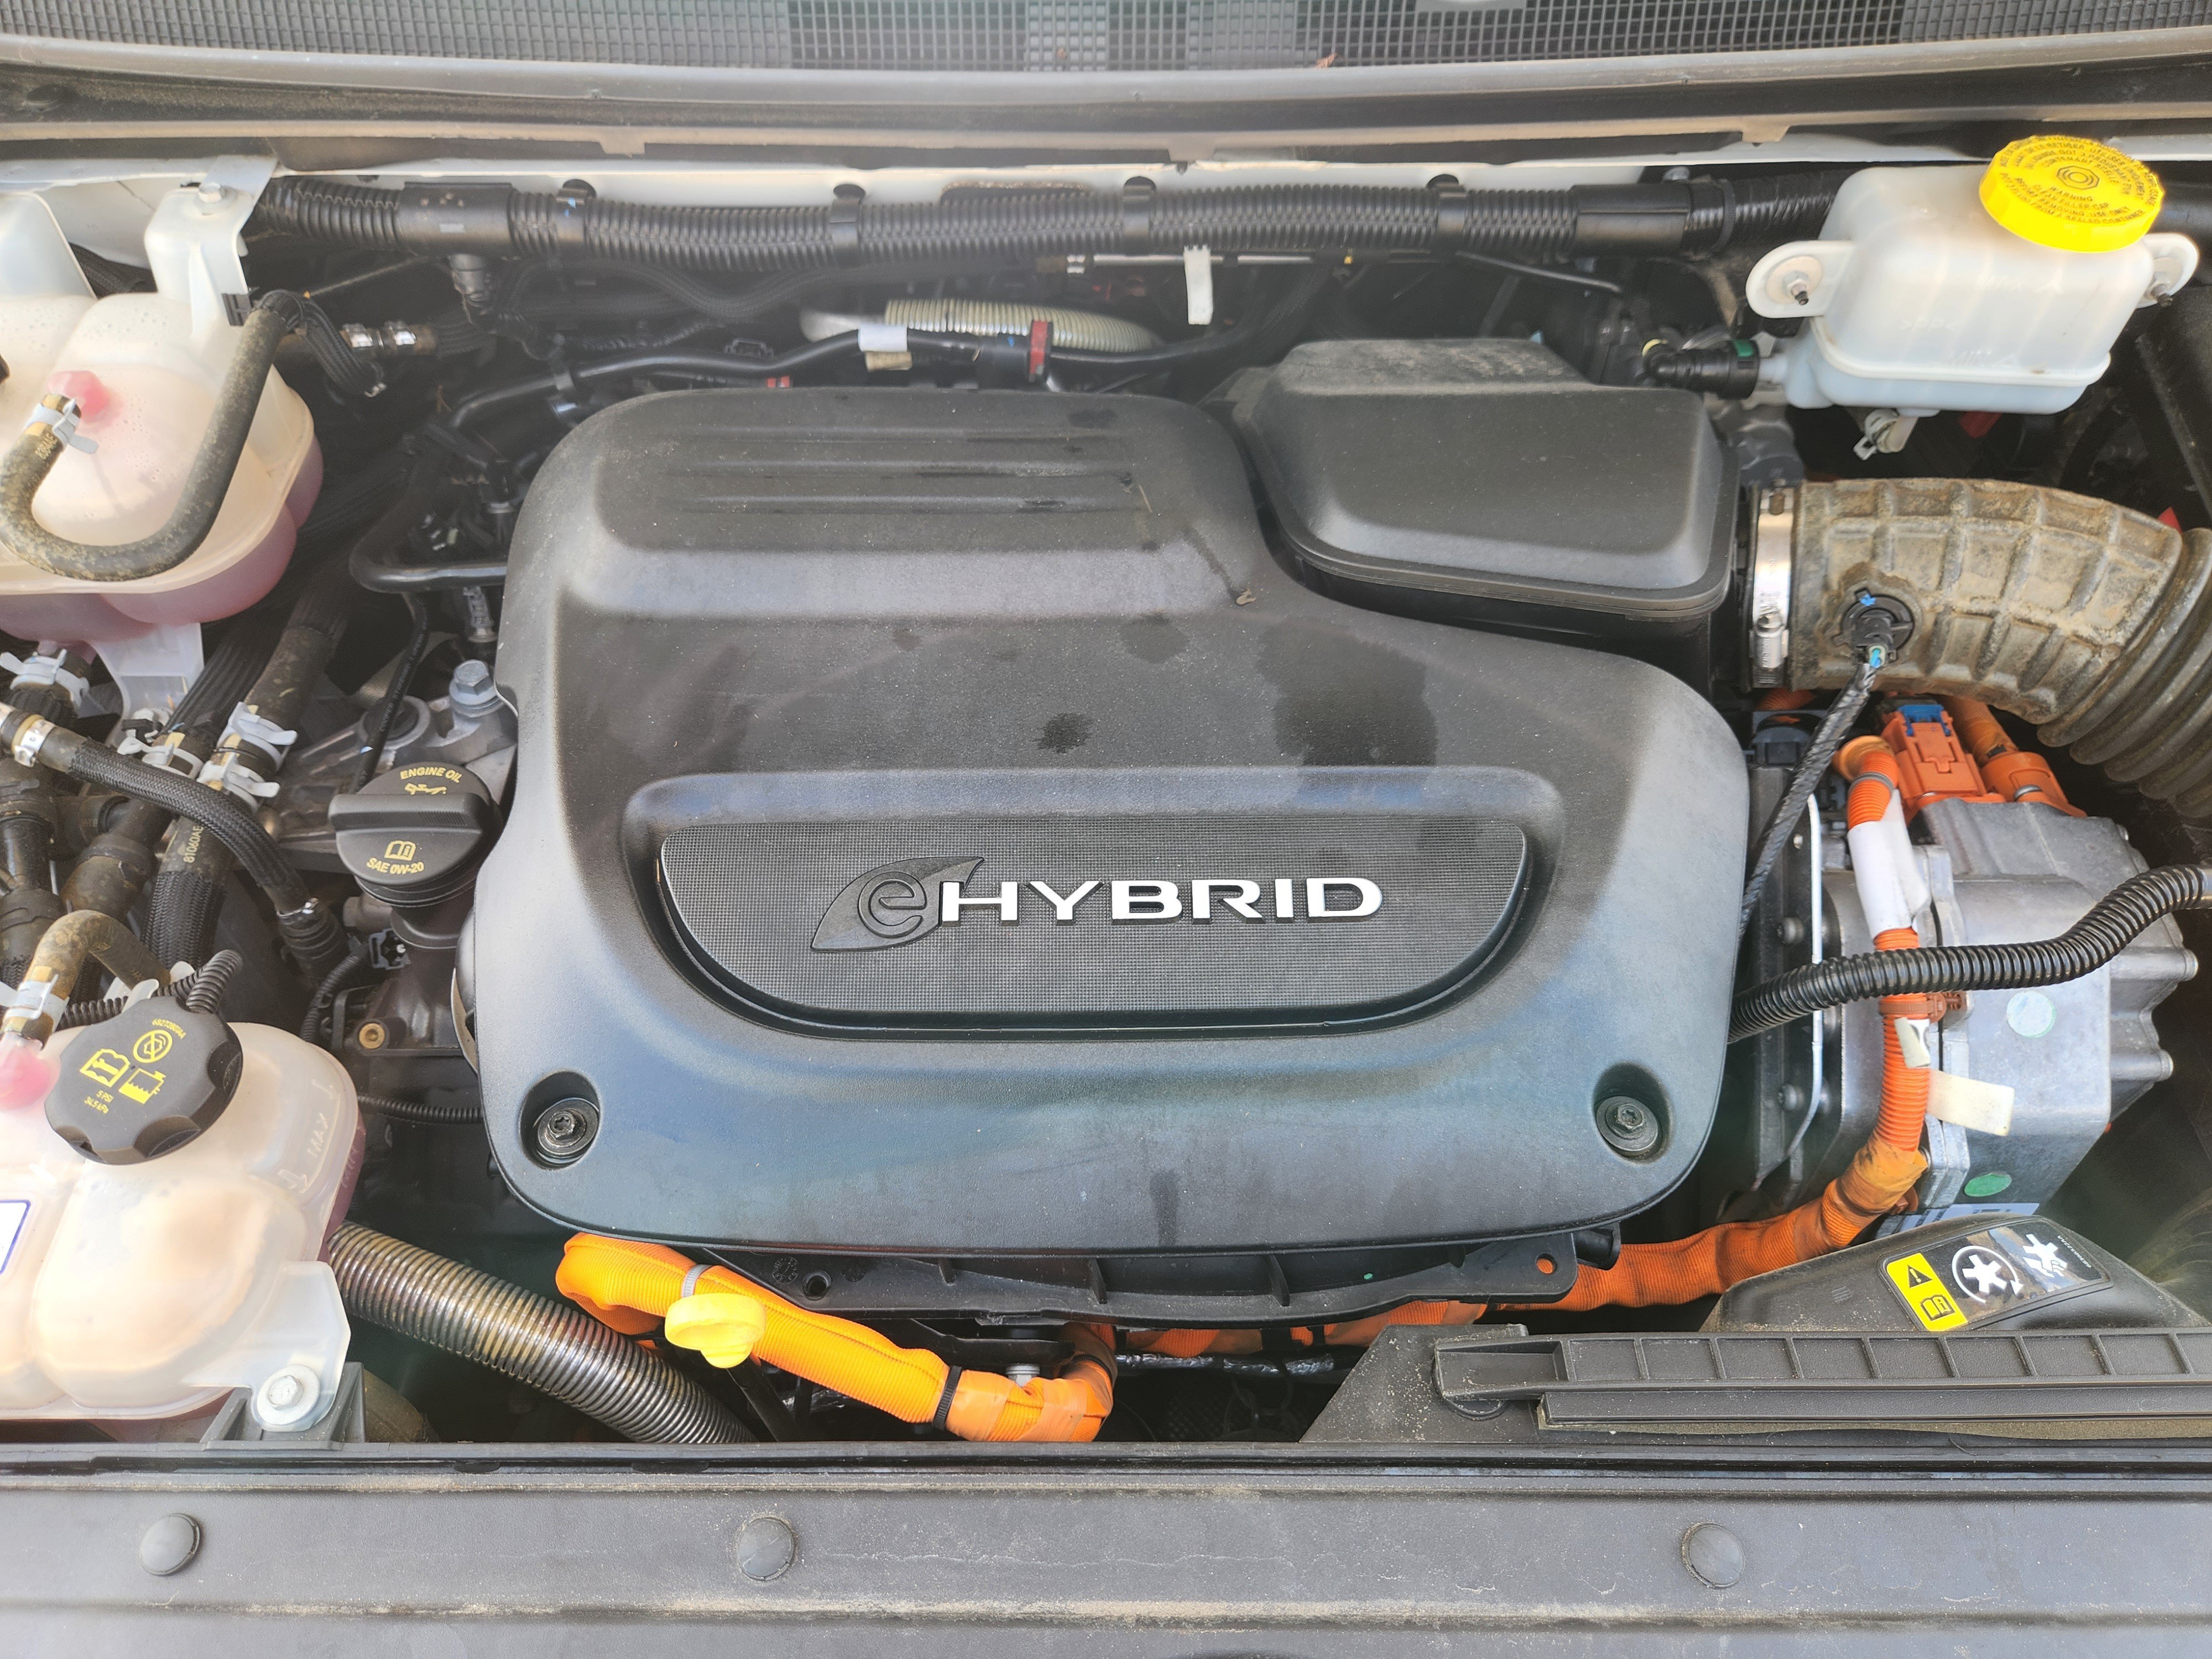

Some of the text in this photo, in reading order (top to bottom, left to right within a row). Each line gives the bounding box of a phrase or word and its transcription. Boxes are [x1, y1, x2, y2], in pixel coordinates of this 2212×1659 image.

[400, 768, 462, 783] ENGINE OIL
[367, 857, 424, 875] SAE 0W-20
[307, 1113, 328, 1157] MAX
